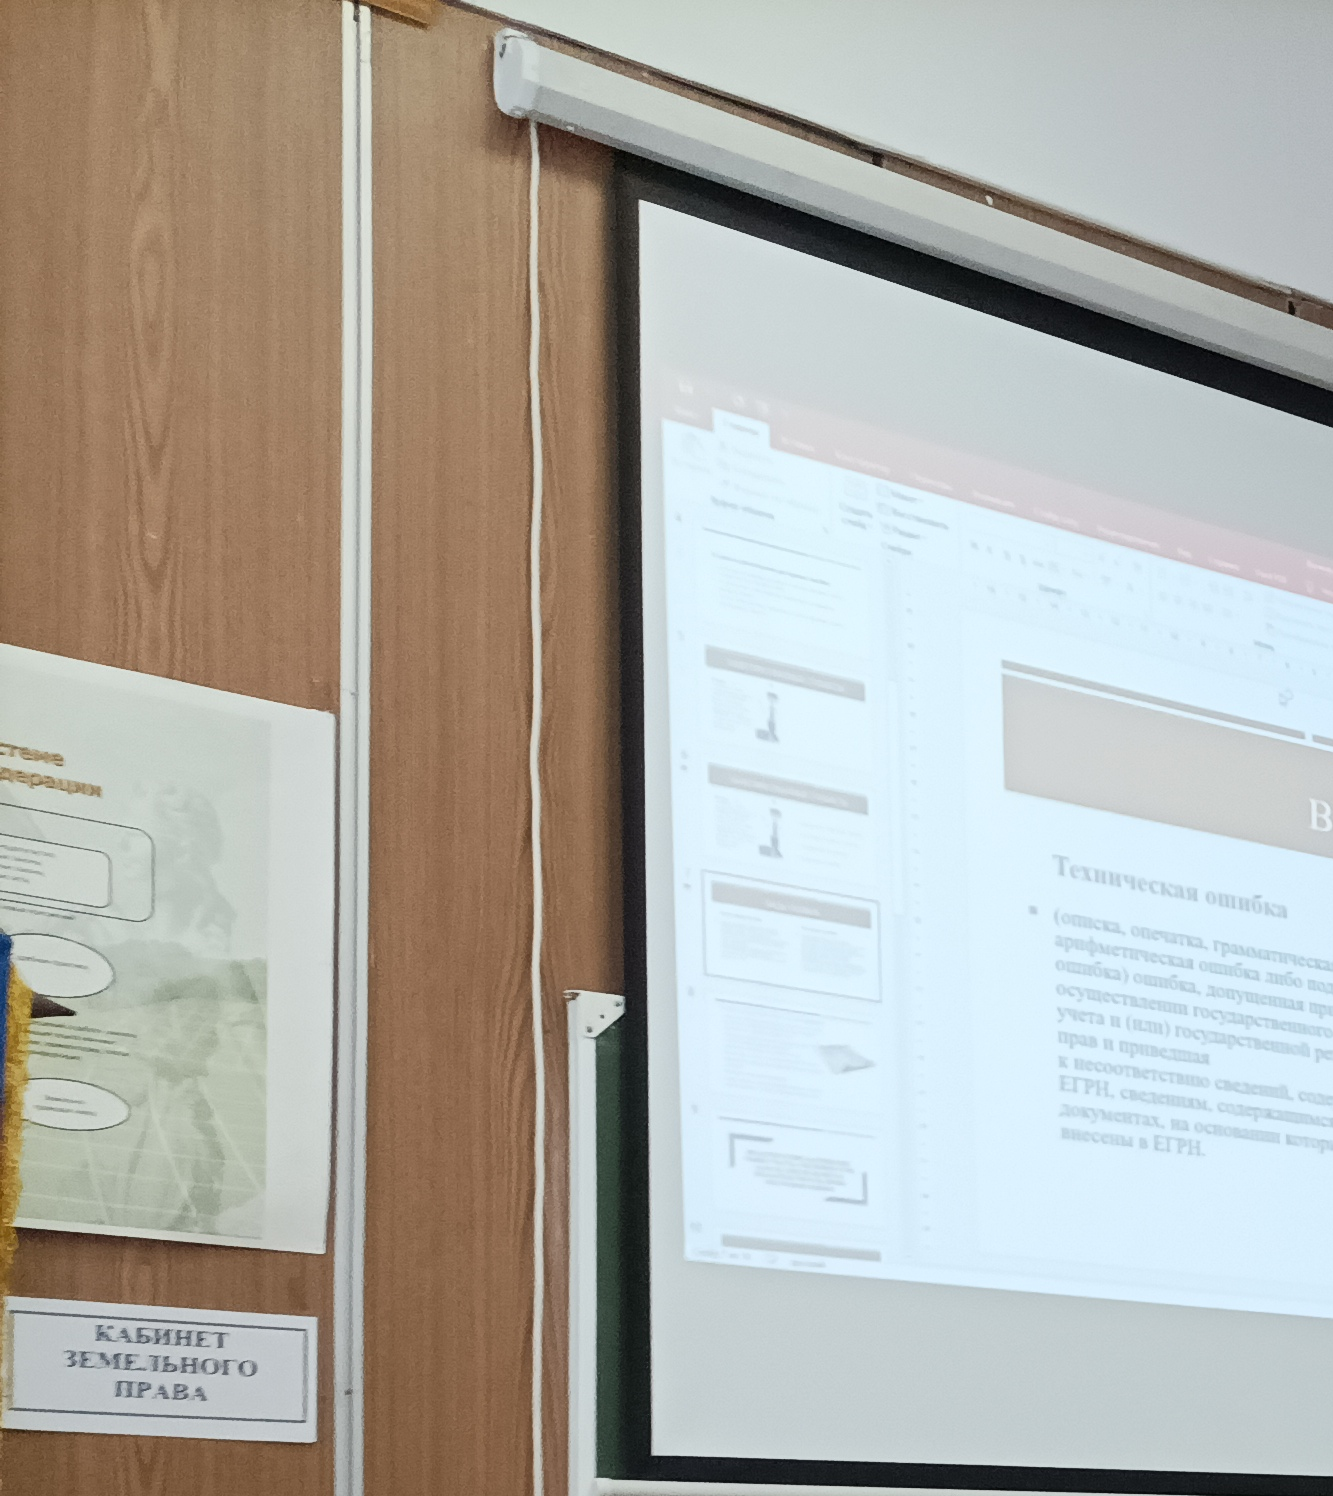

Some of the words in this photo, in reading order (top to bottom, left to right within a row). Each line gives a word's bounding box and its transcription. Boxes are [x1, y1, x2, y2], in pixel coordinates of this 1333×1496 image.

[1052, 854, 1198, 902] Техническая
[1204, 890, 1287, 919] ошибка
[1054, 934, 1194, 970] арифметическая
[1198, 960, 1259, 982] ошибка
[1265, 970, 1302, 988] либо
[1055, 959, 1129, 984] ошибка)
[1205, 984, 1304, 1012] допущенная
[1055, 983, 1188, 1015] осуществлении
[1192, 1005, 1333, 1038] государственного
[1056, 1005, 1105, 1025] учета
[1109, 1014, 1121, 1028] и
[1125, 1015, 1170, 1037] (или)
[1174, 1025, 1310, 1057] государственной
[1057, 1030, 1098, 1050] прав
[1103, 1037, 1113, 1051] и
[1118, 1039, 1210, 1065] приведшая
[1058, 1055, 1068, 1069] к
[1073, 1057, 1210, 1088] несоответствию
[1061, 1126, 1134, 1147] внесены
[1138, 1136, 1149, 1149] в
[1170, 1117, 1189, 1131] на
[1193, 1121, 1281, 1144] основании
[94, 1324, 229, 1348] КАБИНЕТ
[63, 1349, 258, 1377] ЗЕМЕЛЬНОГО
[114, 1380, 207, 1401] ПРАВА
